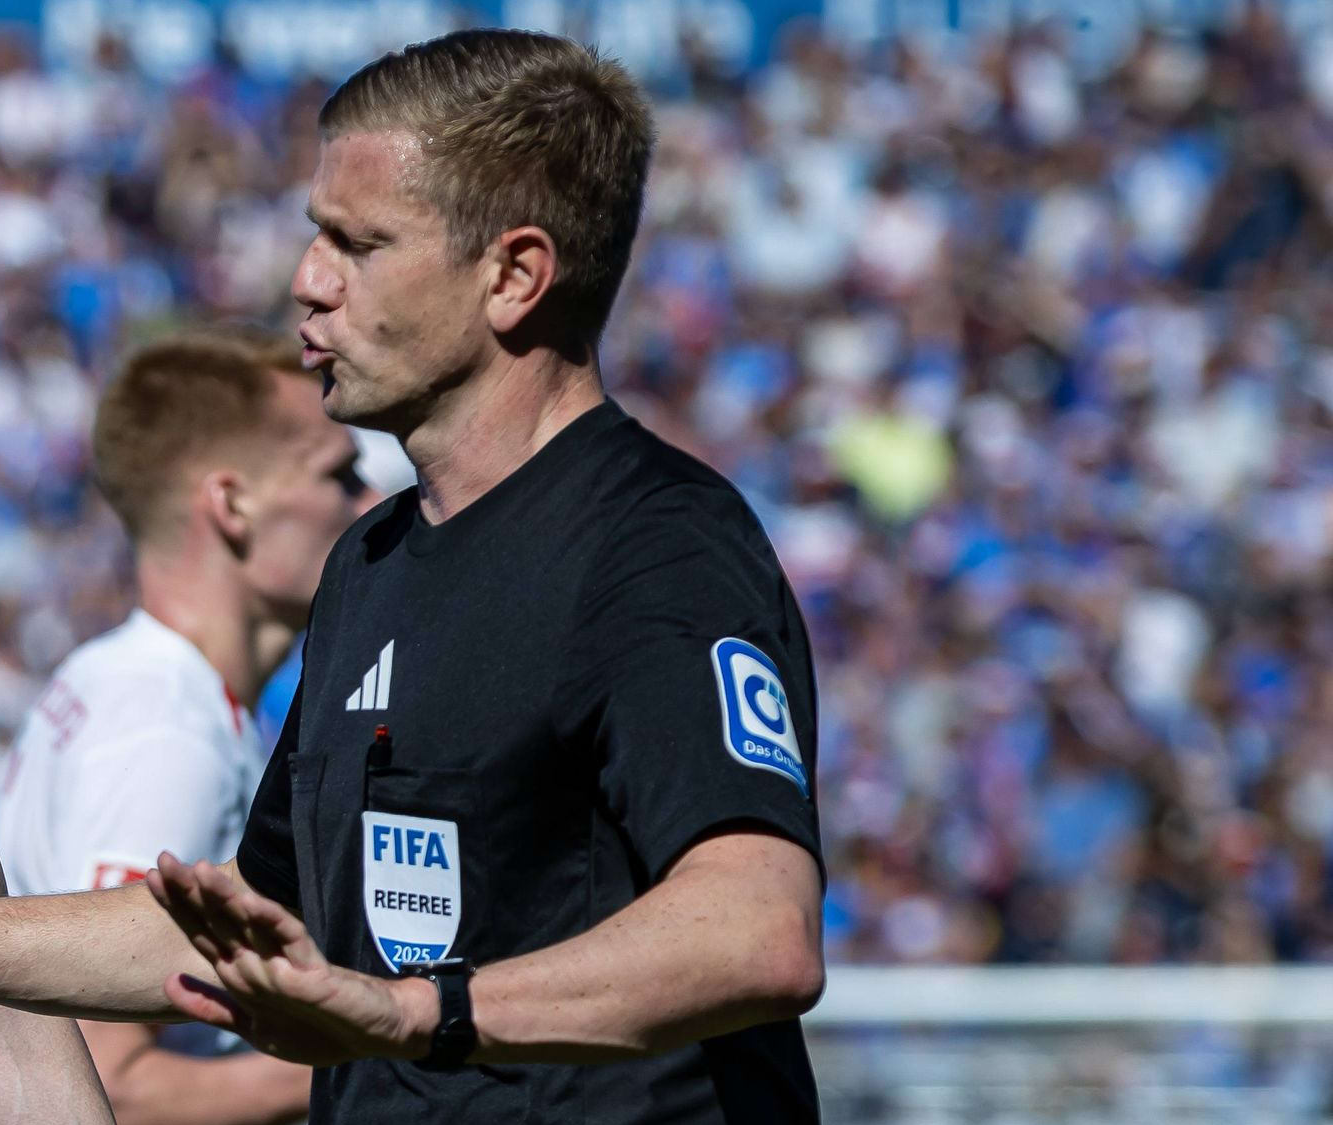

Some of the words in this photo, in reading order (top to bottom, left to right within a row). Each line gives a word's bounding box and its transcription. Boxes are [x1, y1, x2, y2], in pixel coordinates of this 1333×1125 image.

[742, 739, 772, 758] Das
[373, 824, 451, 870] FIFA
[374, 889, 453, 917] REFEREE
[392, 944, 432, 963] 2025
